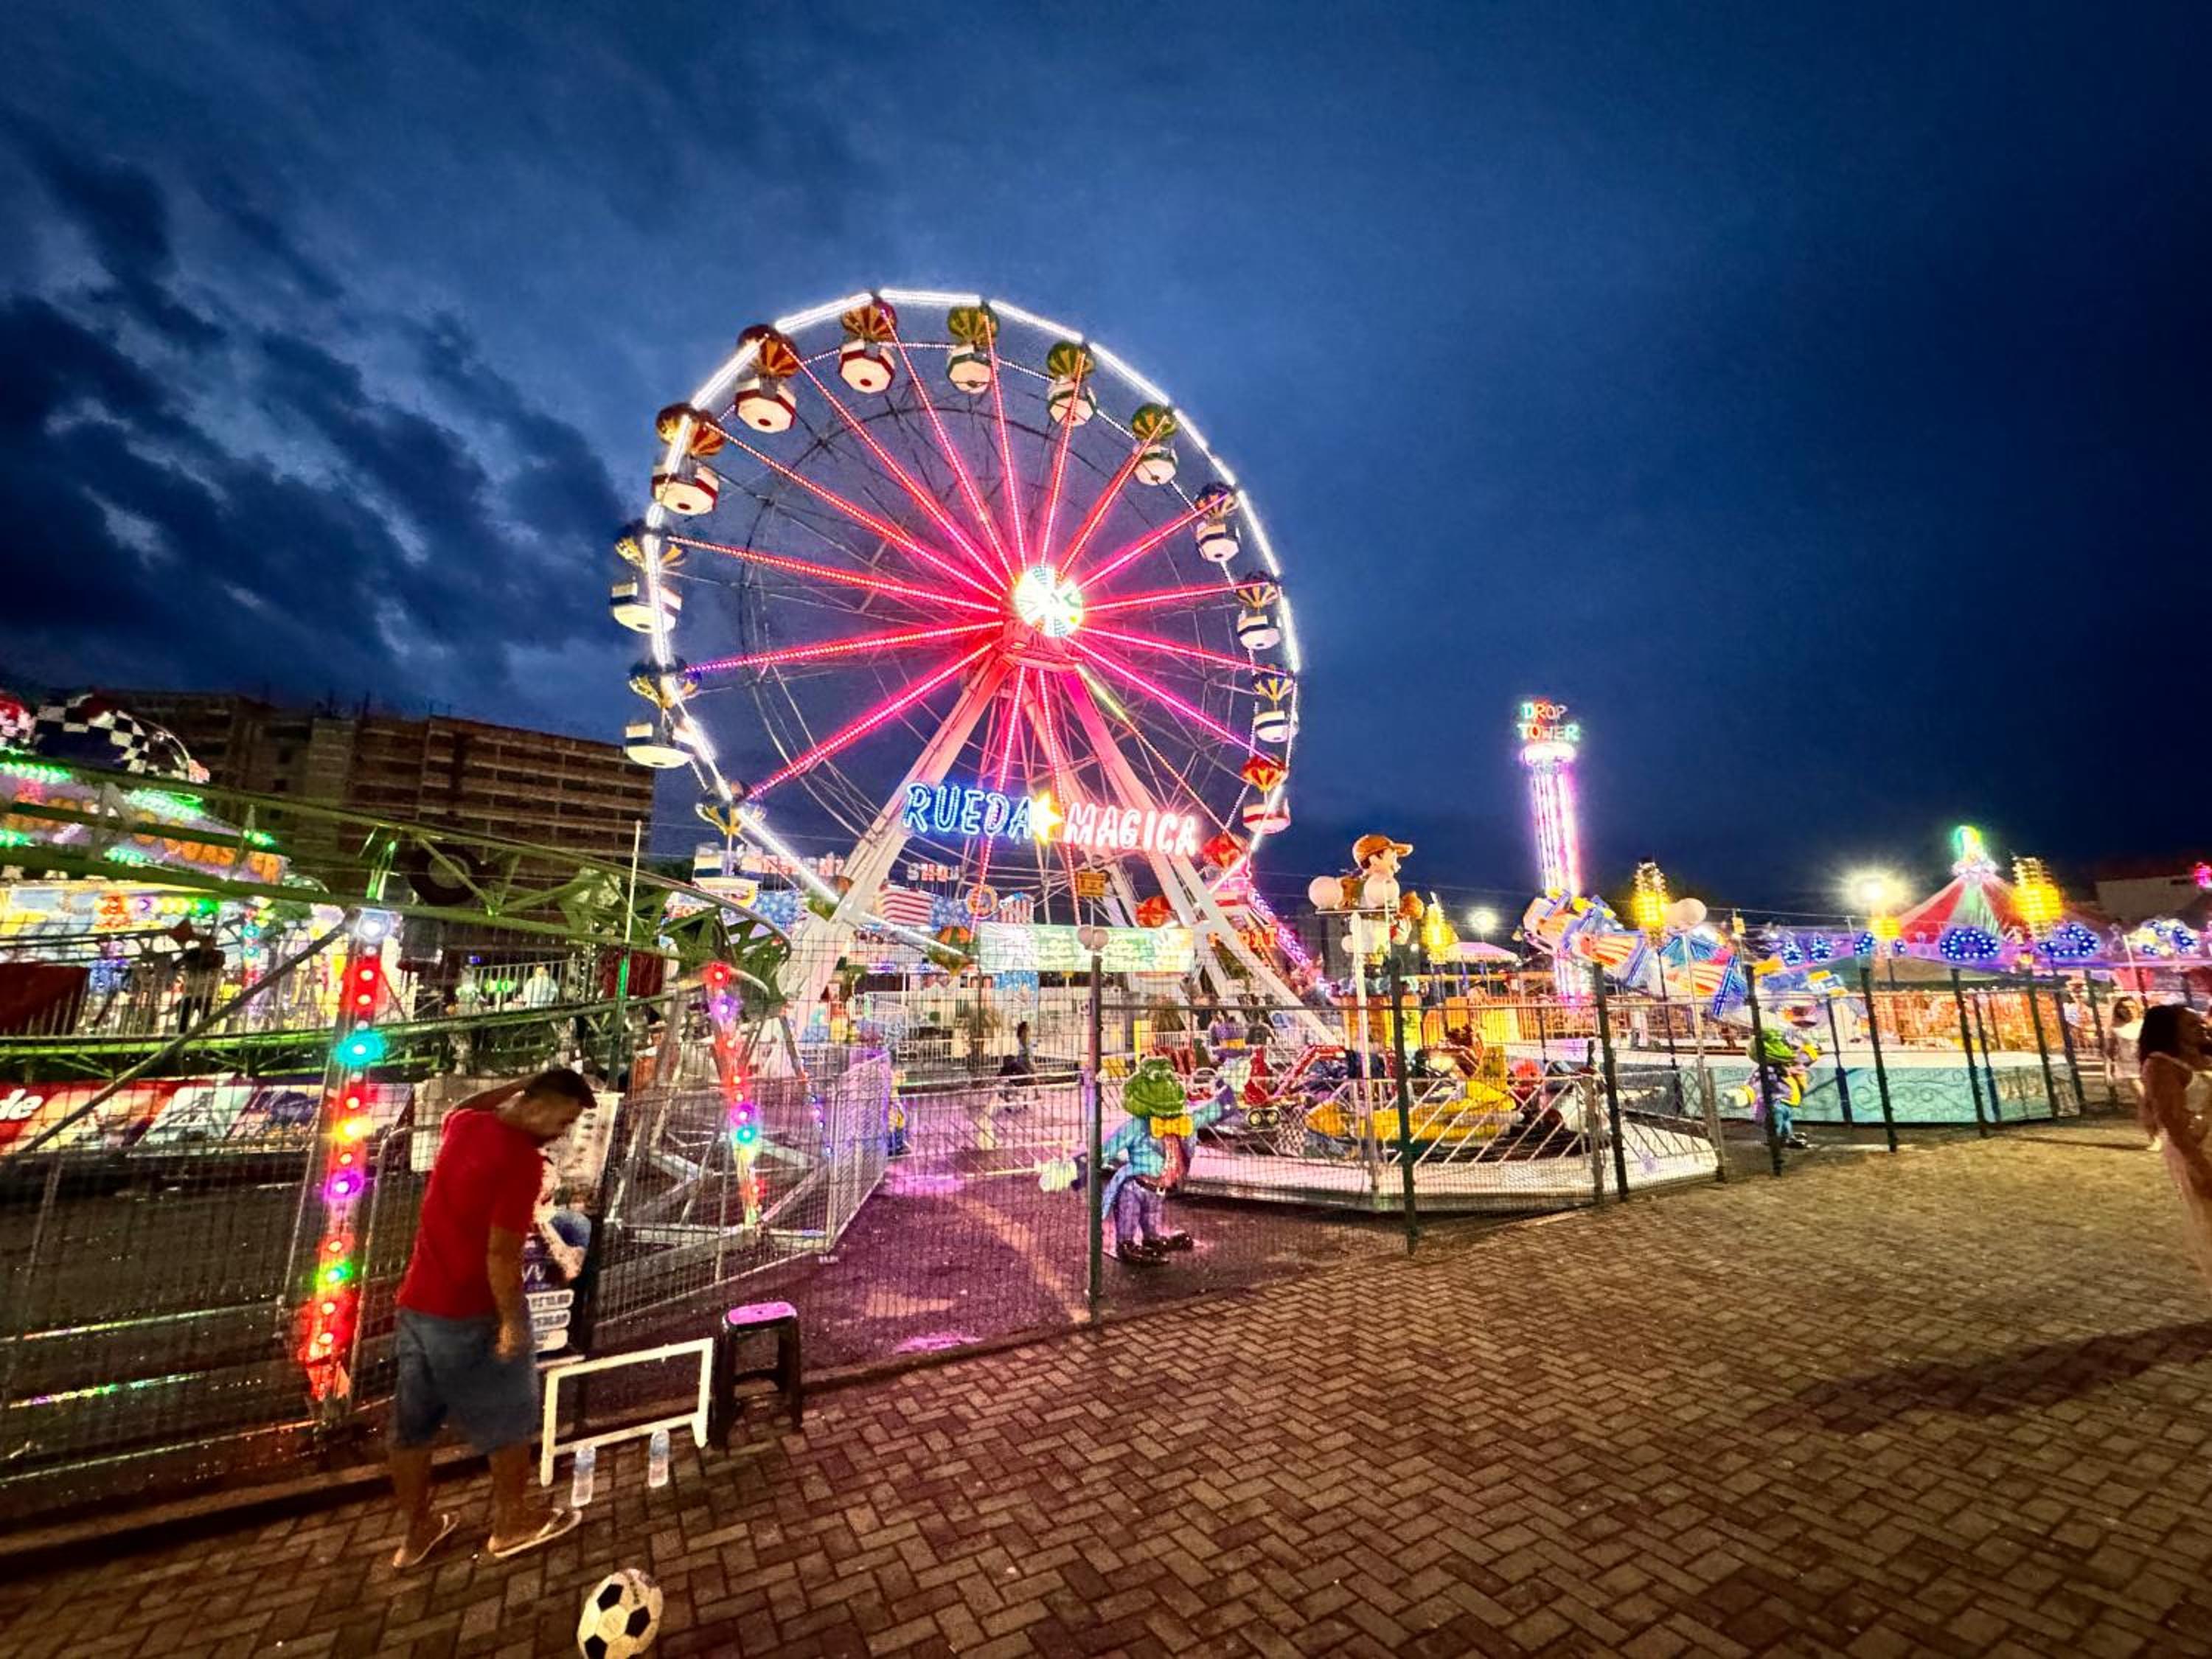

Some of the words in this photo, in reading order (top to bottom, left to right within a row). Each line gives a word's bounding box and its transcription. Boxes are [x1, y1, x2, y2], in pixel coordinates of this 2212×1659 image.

[1521, 701, 1568, 720] DROP
[1517, 723, 1581, 742] TOWER
[903, 782, 1032, 843] RUEDA
[1064, 801, 1197, 856] MAGICA
